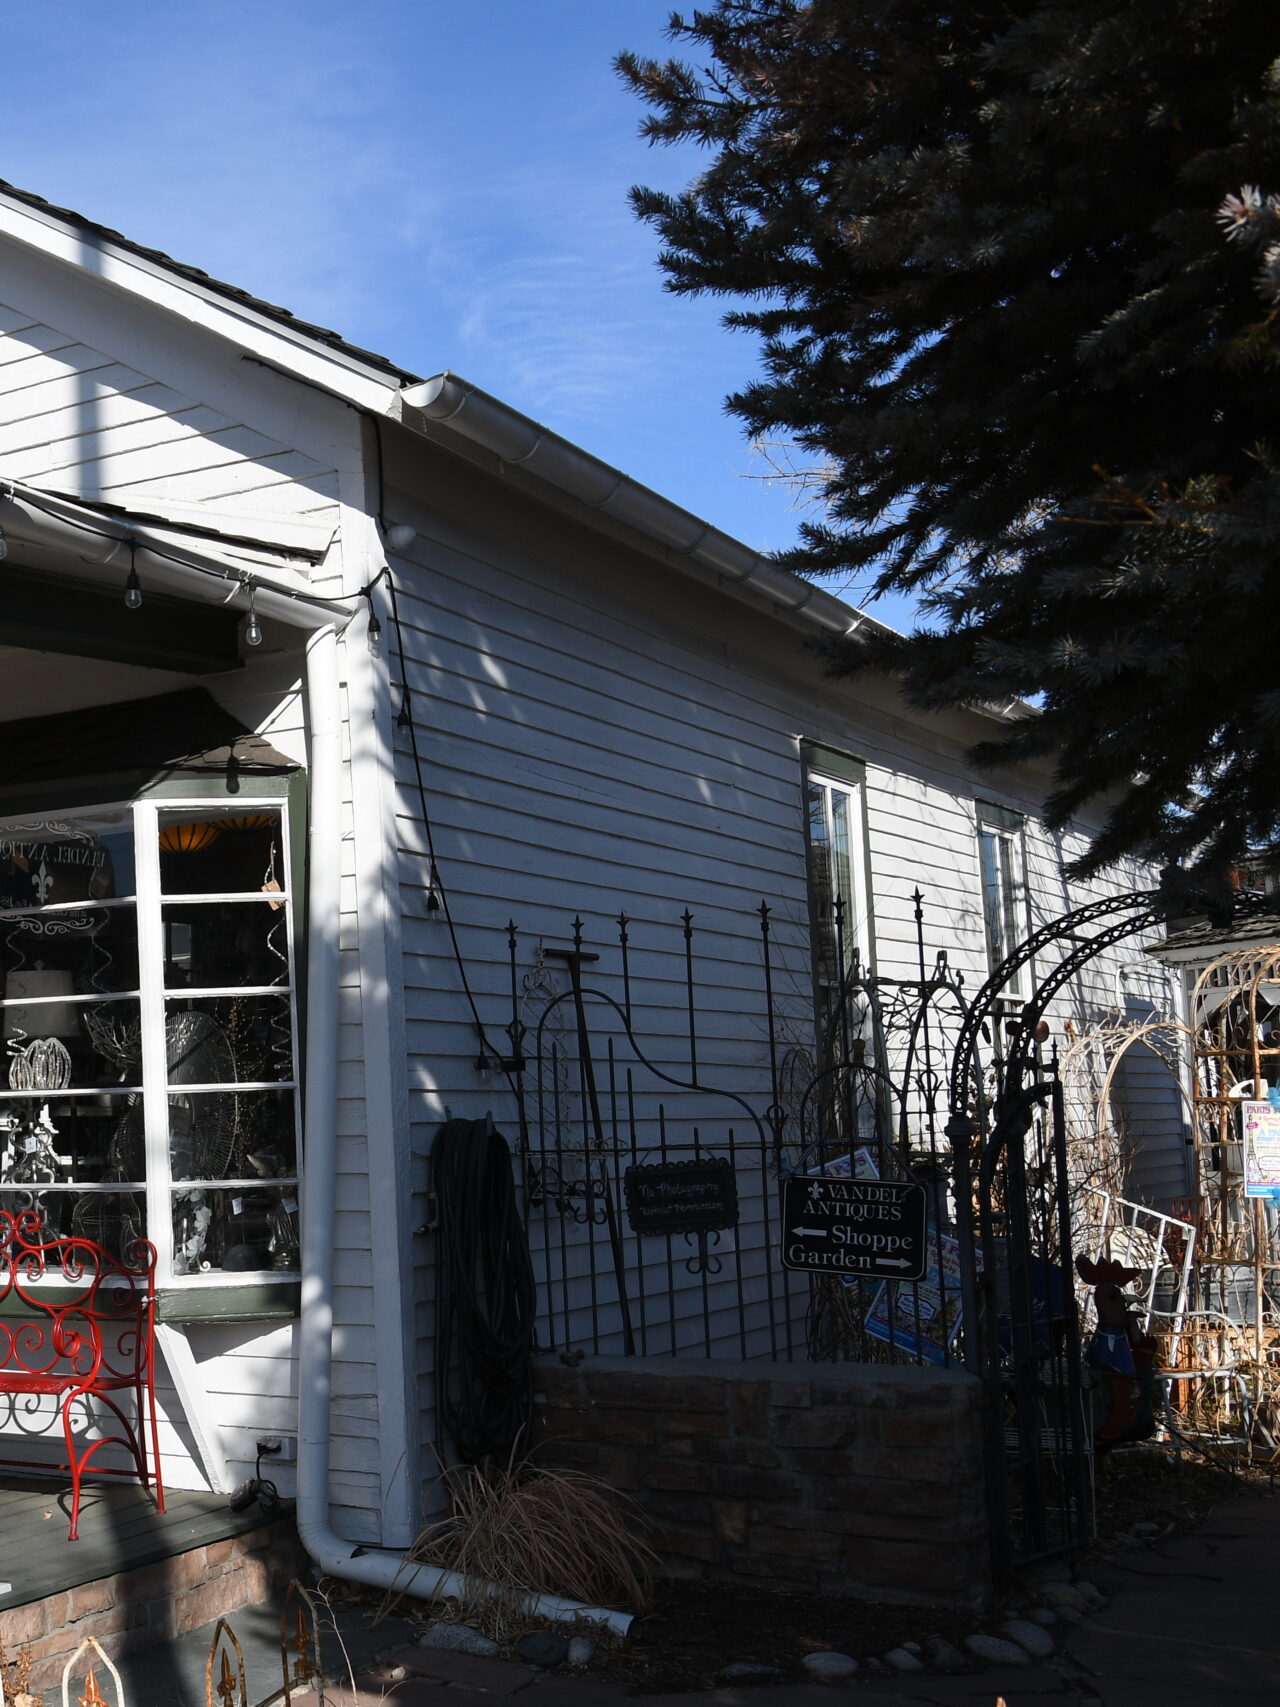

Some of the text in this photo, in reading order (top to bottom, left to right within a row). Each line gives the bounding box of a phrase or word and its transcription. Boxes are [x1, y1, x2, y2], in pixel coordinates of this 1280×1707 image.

[1246, 1105, 1271, 1114] PARIS
[827, 1184, 902, 1204] VANDEL
[803, 1200, 902, 1222] ANTIQUES
[831, 1225, 913, 1252] Shoppe
[789, 1244, 873, 1269] Garden
